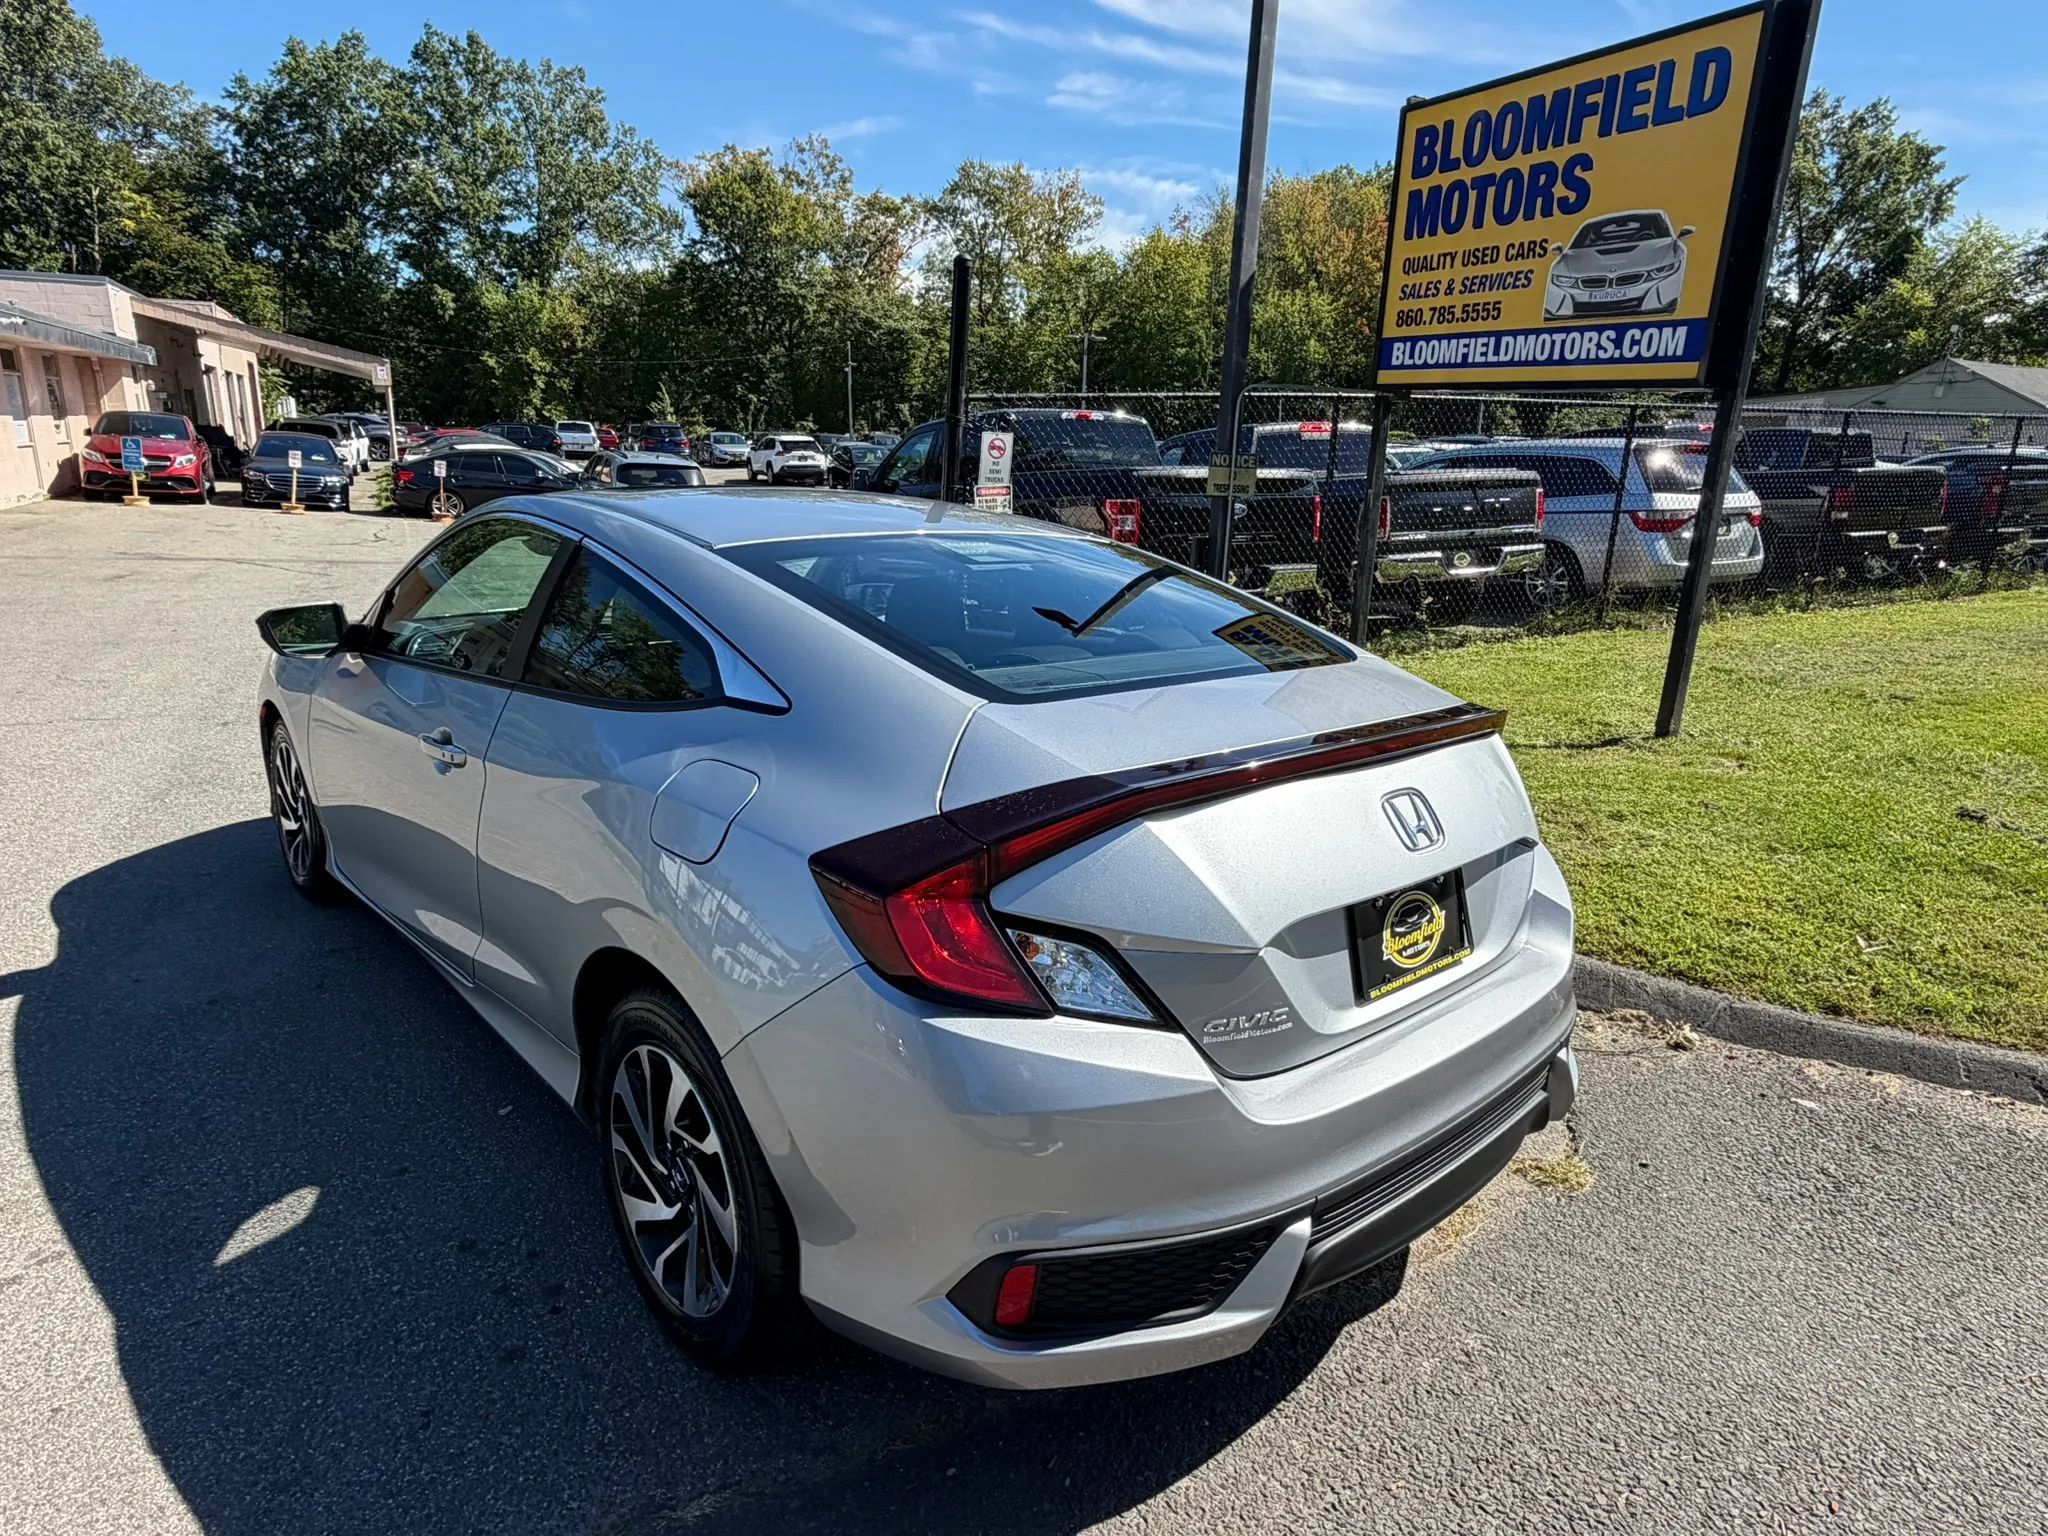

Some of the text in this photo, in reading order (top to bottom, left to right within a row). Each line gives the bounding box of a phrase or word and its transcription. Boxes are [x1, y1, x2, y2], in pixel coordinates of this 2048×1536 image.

[1411, 46, 1732, 180] BLOOMFIELD
[1404, 153, 1593, 241] MOTORS
[1402, 238, 1549, 276] QUALITY USED CARS
[1399, 269, 1535, 301] SALES & SERVICES
[1395, 301, 1502, 328] 860.785.5555
[1391, 326, 1688, 366] BLOOMFIELDMOTORS.COM
[1211, 453, 1257, 468] NOICE
[1386, 916, 1443, 955] Bloomfield
[1370, 948, 1472, 999] BLOOMFIELDMOTORS.COM
[1202, 1021, 1294, 1044] BloomfieldMotors.com
[1203, 1007, 1289, 1033] CIVIC
